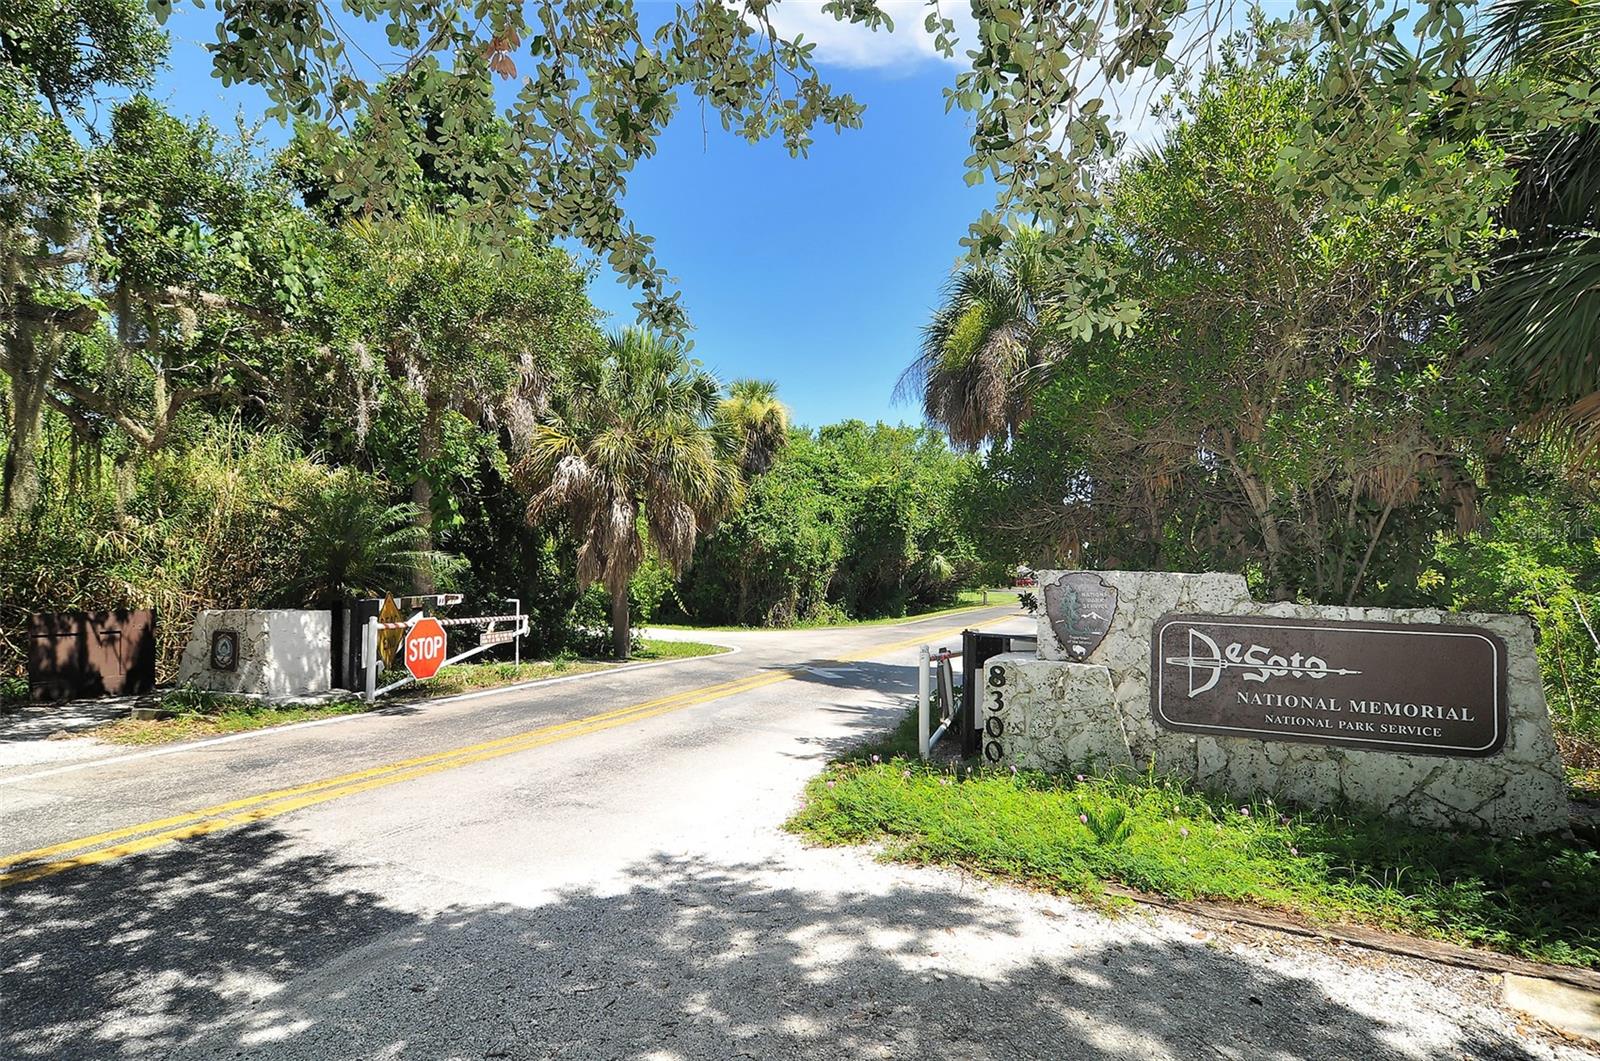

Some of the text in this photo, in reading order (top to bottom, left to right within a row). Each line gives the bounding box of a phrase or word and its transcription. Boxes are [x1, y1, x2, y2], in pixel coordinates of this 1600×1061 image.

[409, 636, 443, 662] STOP
[1188, 628, 1328, 698] DeSoto
[985, 665, 1006, 763] 8300
[1236, 691, 1475, 722] NATIONAL MEMORIAL
[1264, 714, 1443, 738] NATIONAL PARK SERVICE
